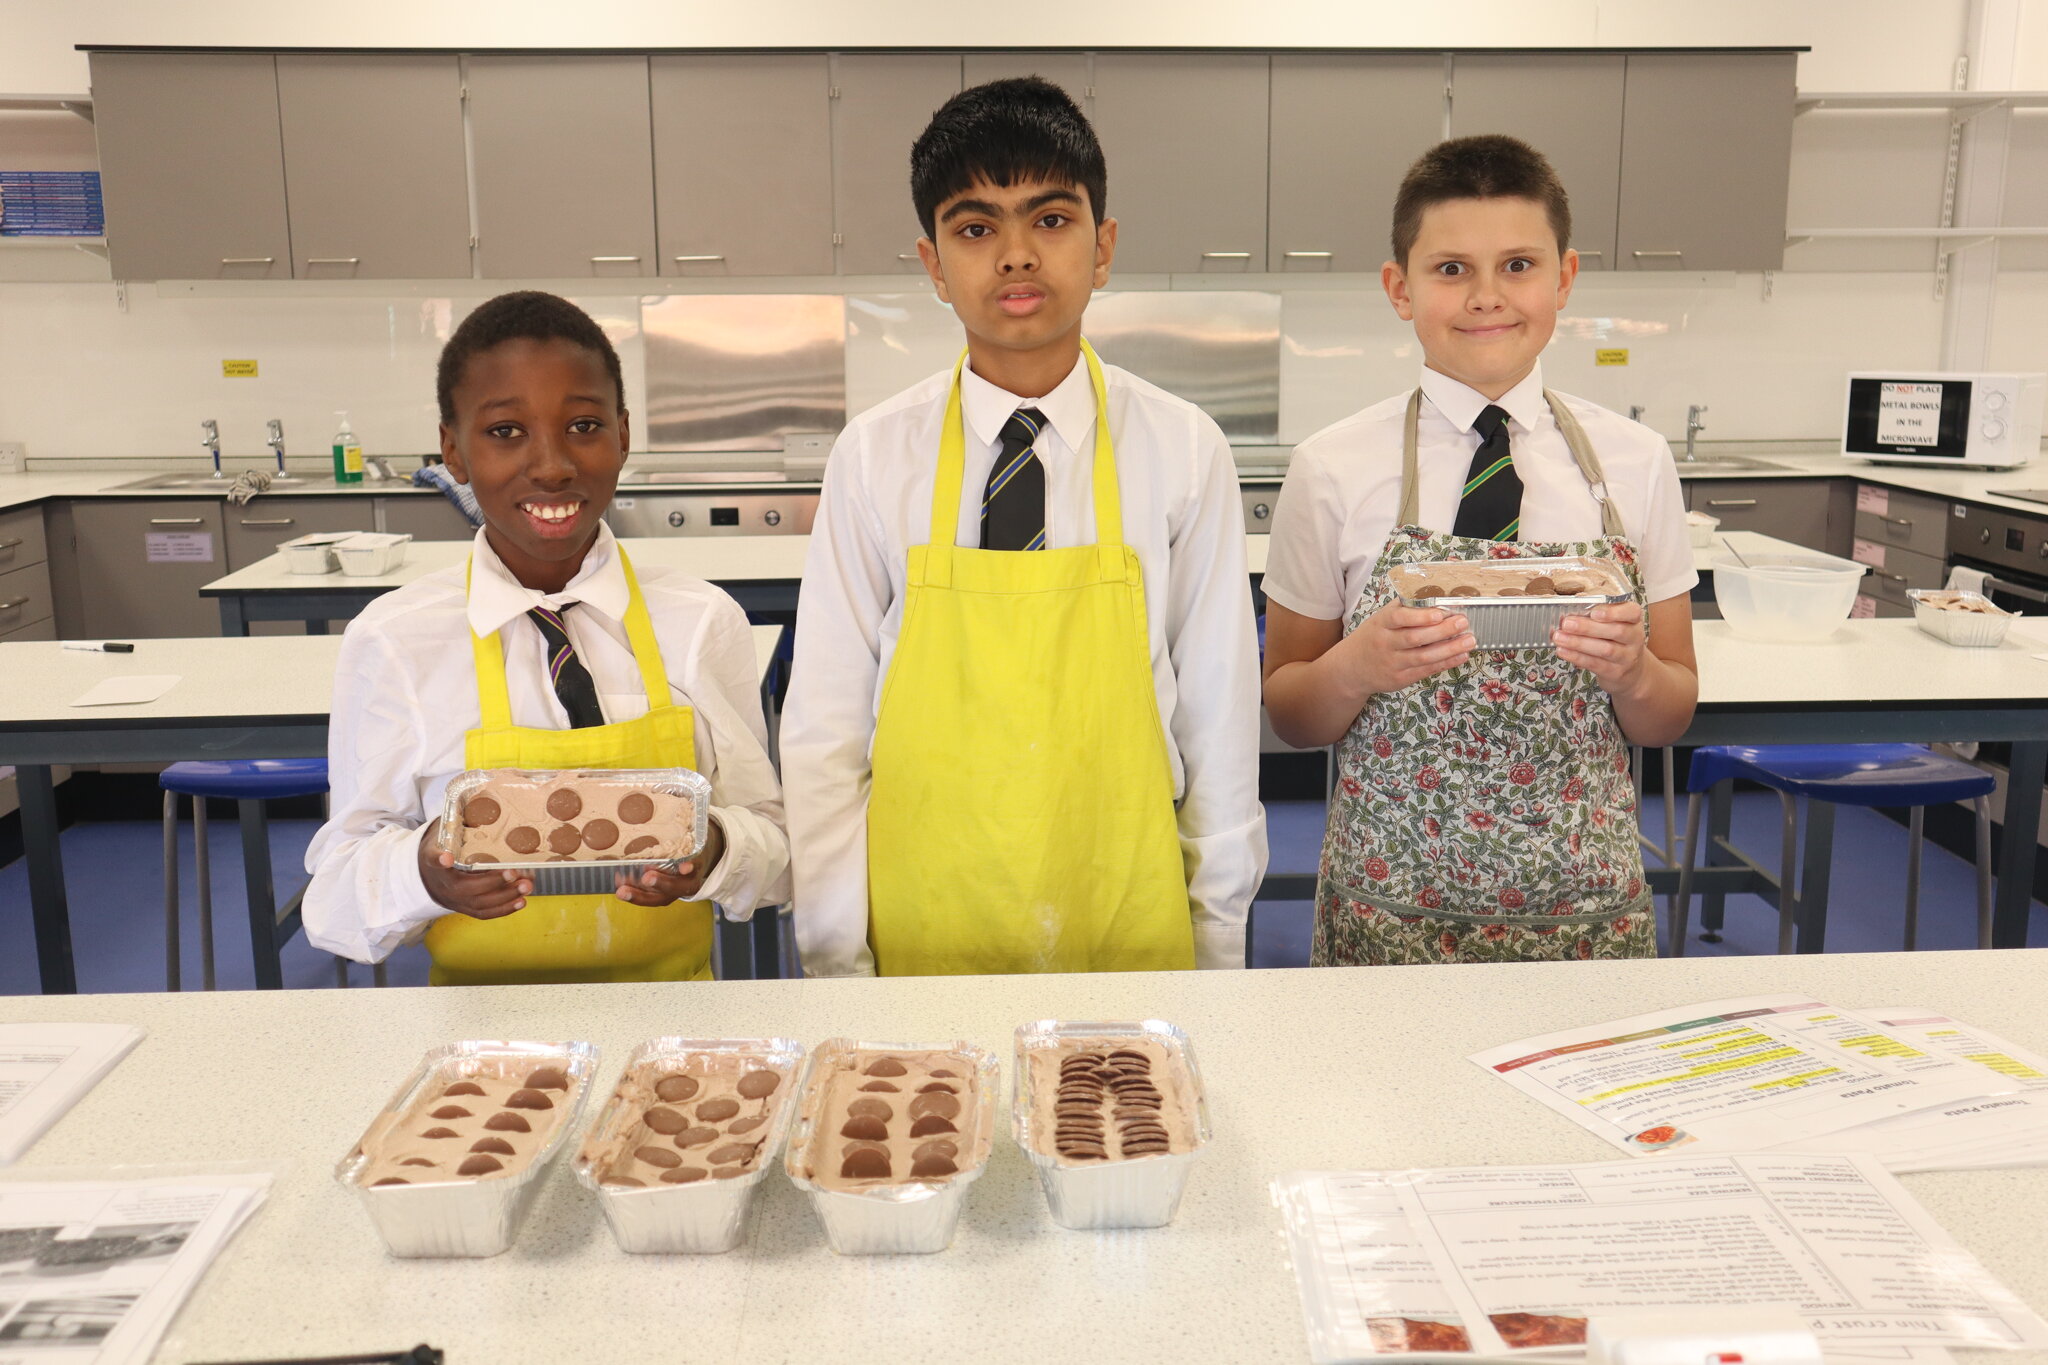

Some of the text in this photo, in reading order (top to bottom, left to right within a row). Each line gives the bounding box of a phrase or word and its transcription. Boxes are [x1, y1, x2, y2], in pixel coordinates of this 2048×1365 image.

[1881, 402, 1940, 410] METAL BOWLS
[1896, 418, 1905, 426] IN
[1881, 434, 1932, 444] MICROWAVE
[1839, 1079, 1919, 1100] Tomato Pasta
[1944, 1099, 2030, 1118] Tomato Pasta
[1831, 1320, 1888, 1331] crust
[1895, 1320, 1947, 1332] Thin
